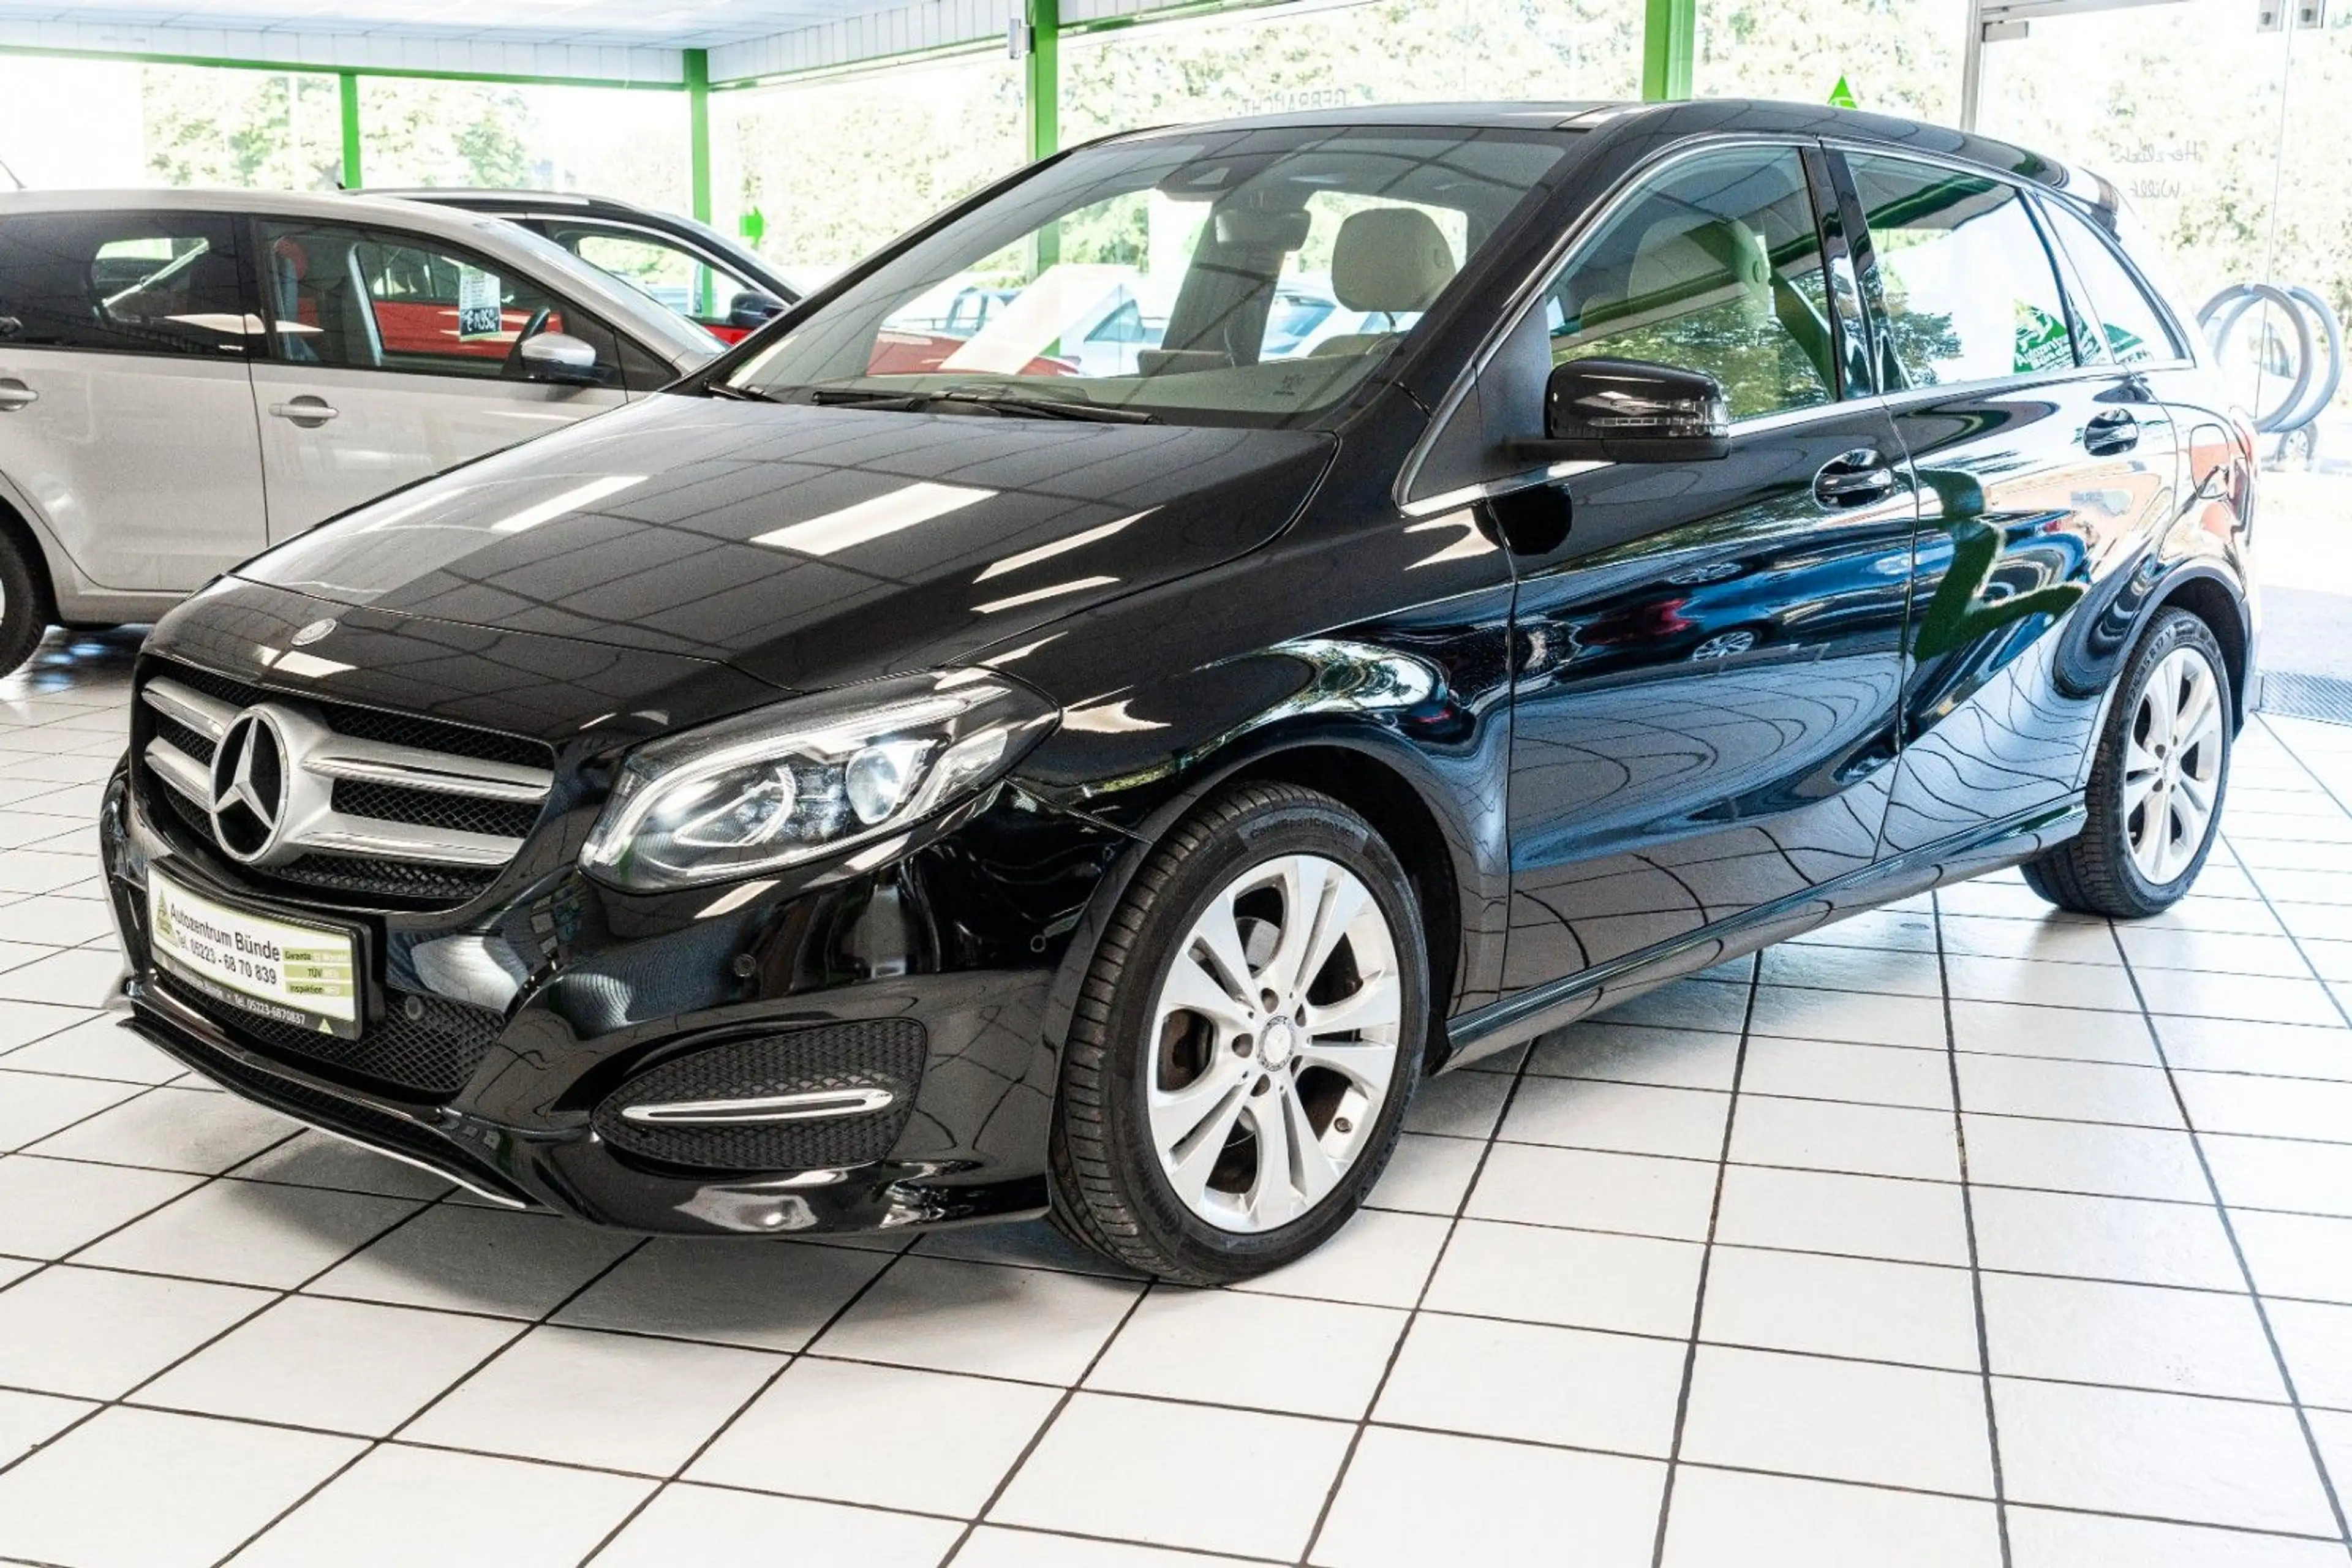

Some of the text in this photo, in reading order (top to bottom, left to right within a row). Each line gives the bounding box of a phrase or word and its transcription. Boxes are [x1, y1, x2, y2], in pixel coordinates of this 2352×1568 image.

[170, 903, 281, 962] Autozentrum Bünde
[224, 954, 236, 973] 68
[238, 959, 252, 978] 70
[255, 964, 277, 985] 839
